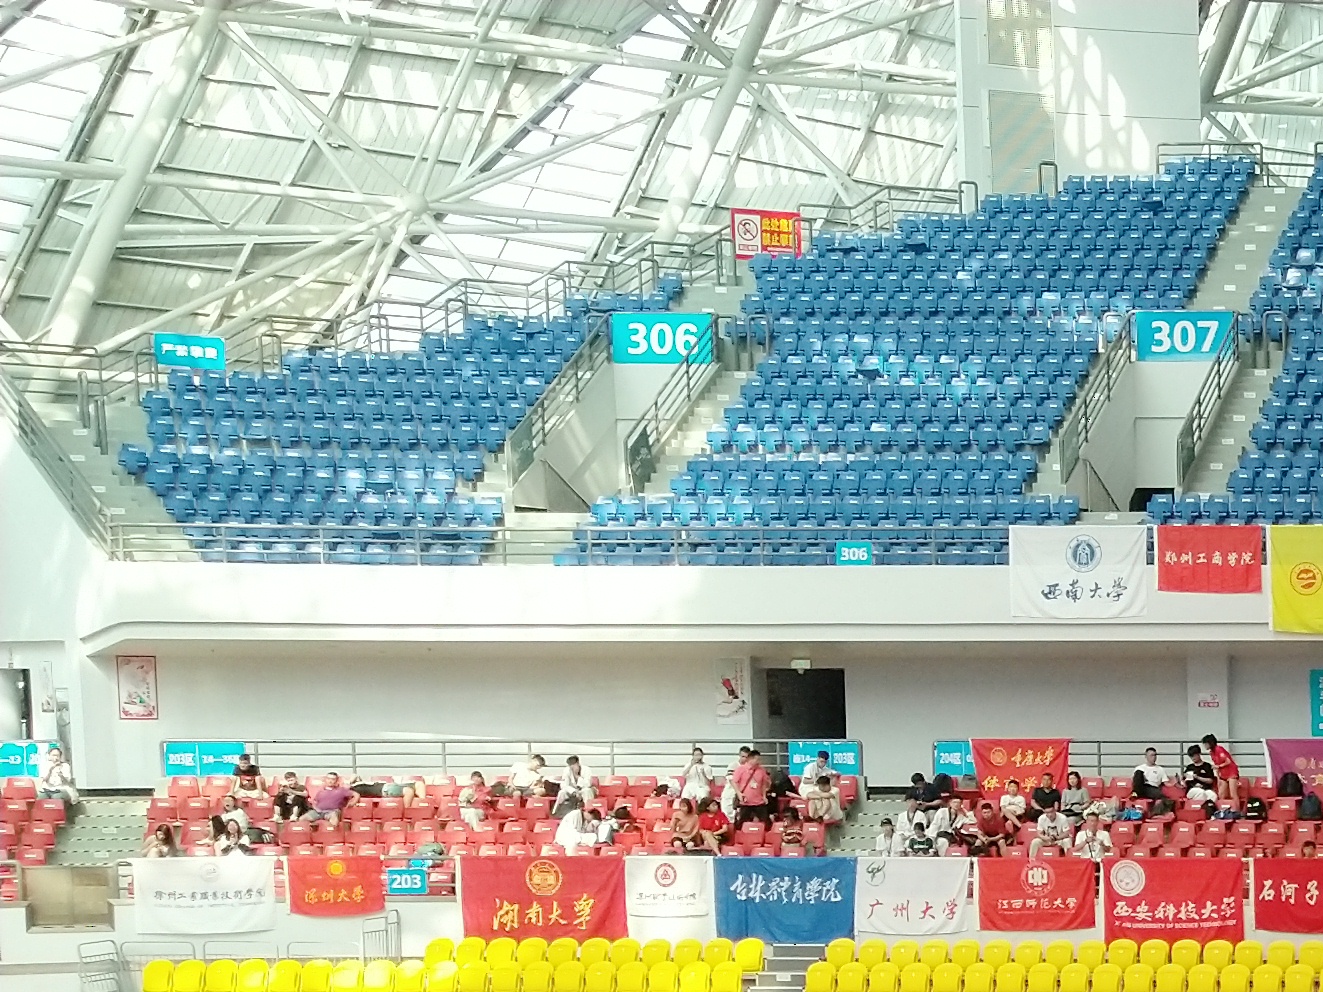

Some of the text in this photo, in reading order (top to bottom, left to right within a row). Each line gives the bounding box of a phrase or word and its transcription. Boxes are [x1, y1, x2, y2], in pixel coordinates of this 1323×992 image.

[627, 321, 698, 356] 306
[1151, 321, 1219, 353] 307
[840, 547, 868, 561] 306
[1165, 550, 1255, 567] 郑州工商学院
[391, 875, 422, 889] 203
[867, 898, 958, 922] 广州大学
